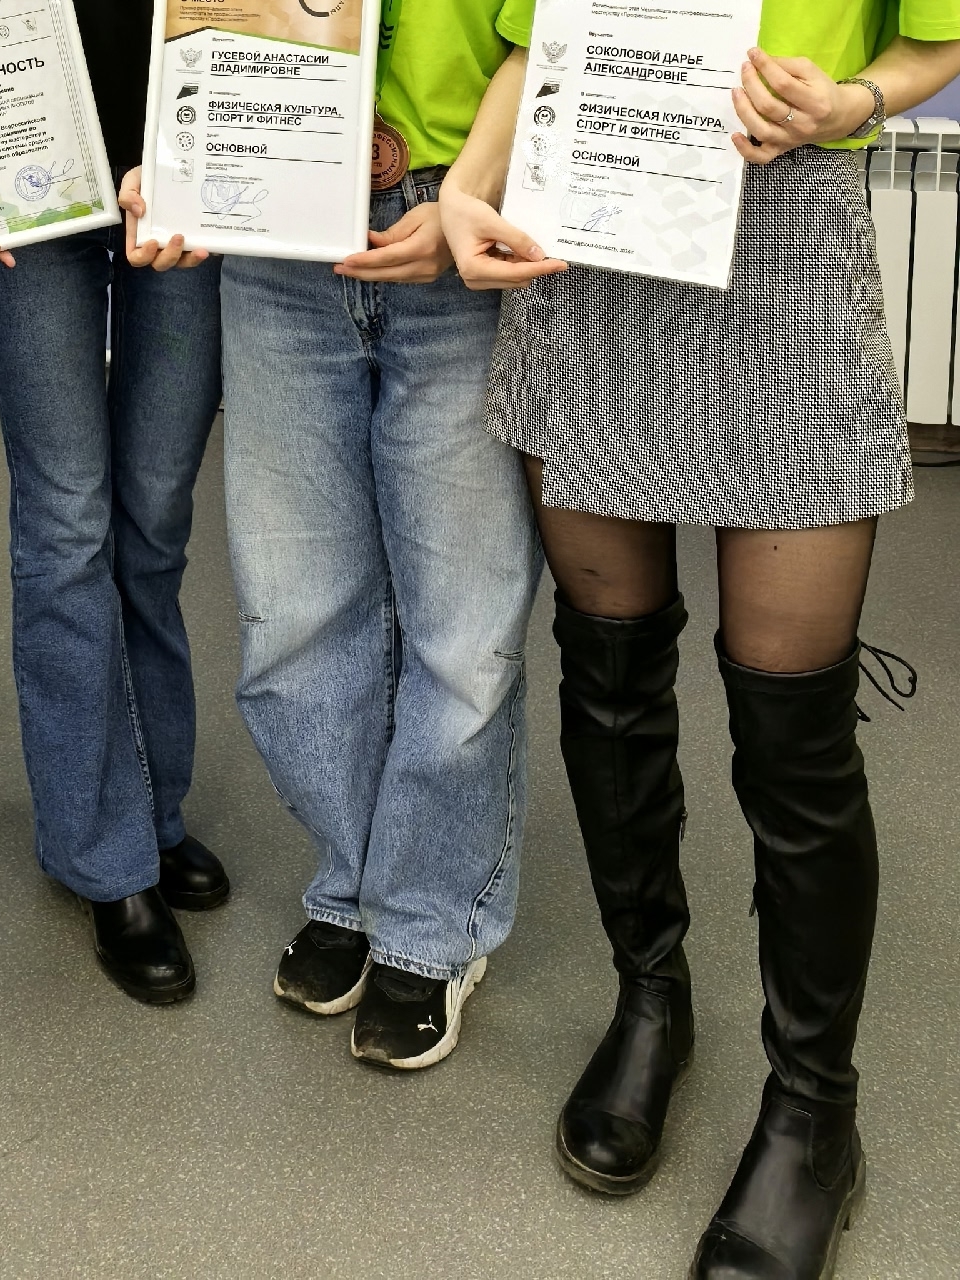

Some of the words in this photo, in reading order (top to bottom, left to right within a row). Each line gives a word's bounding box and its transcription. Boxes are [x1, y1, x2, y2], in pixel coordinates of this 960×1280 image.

[211, 50, 261, 62] ГУСЕВОЙ
[263, 53, 329, 64] АНАСТАСИИ
[586, 45, 661, 62] СОКОЛОВОЙ
[662, 52, 704, 65] ДАРЬЕ
[210, 63, 301, 76] ВЛАДИМИРОВНЕ
[583, 62, 688, 82] АЛЕКСАНДРОВНЕ
[208, 100, 282, 113] ФИЗИЧЕСКАЯ
[578, 102, 660, 122] ФИЗИЧЕСКАЯ
[207, 112, 244, 123] СПОРТ
[246, 114, 254, 122] И
[256, 115, 302, 126] ФИТНЕС
[576, 118, 616, 132] СПОРТ
[618, 124, 628, 134] И
[630, 126, 681, 141] ФИТНЕС
[205, 142, 268, 154] ОСНОВНОЙ
[571, 149, 640, 167] ОСНОВНОЙ
